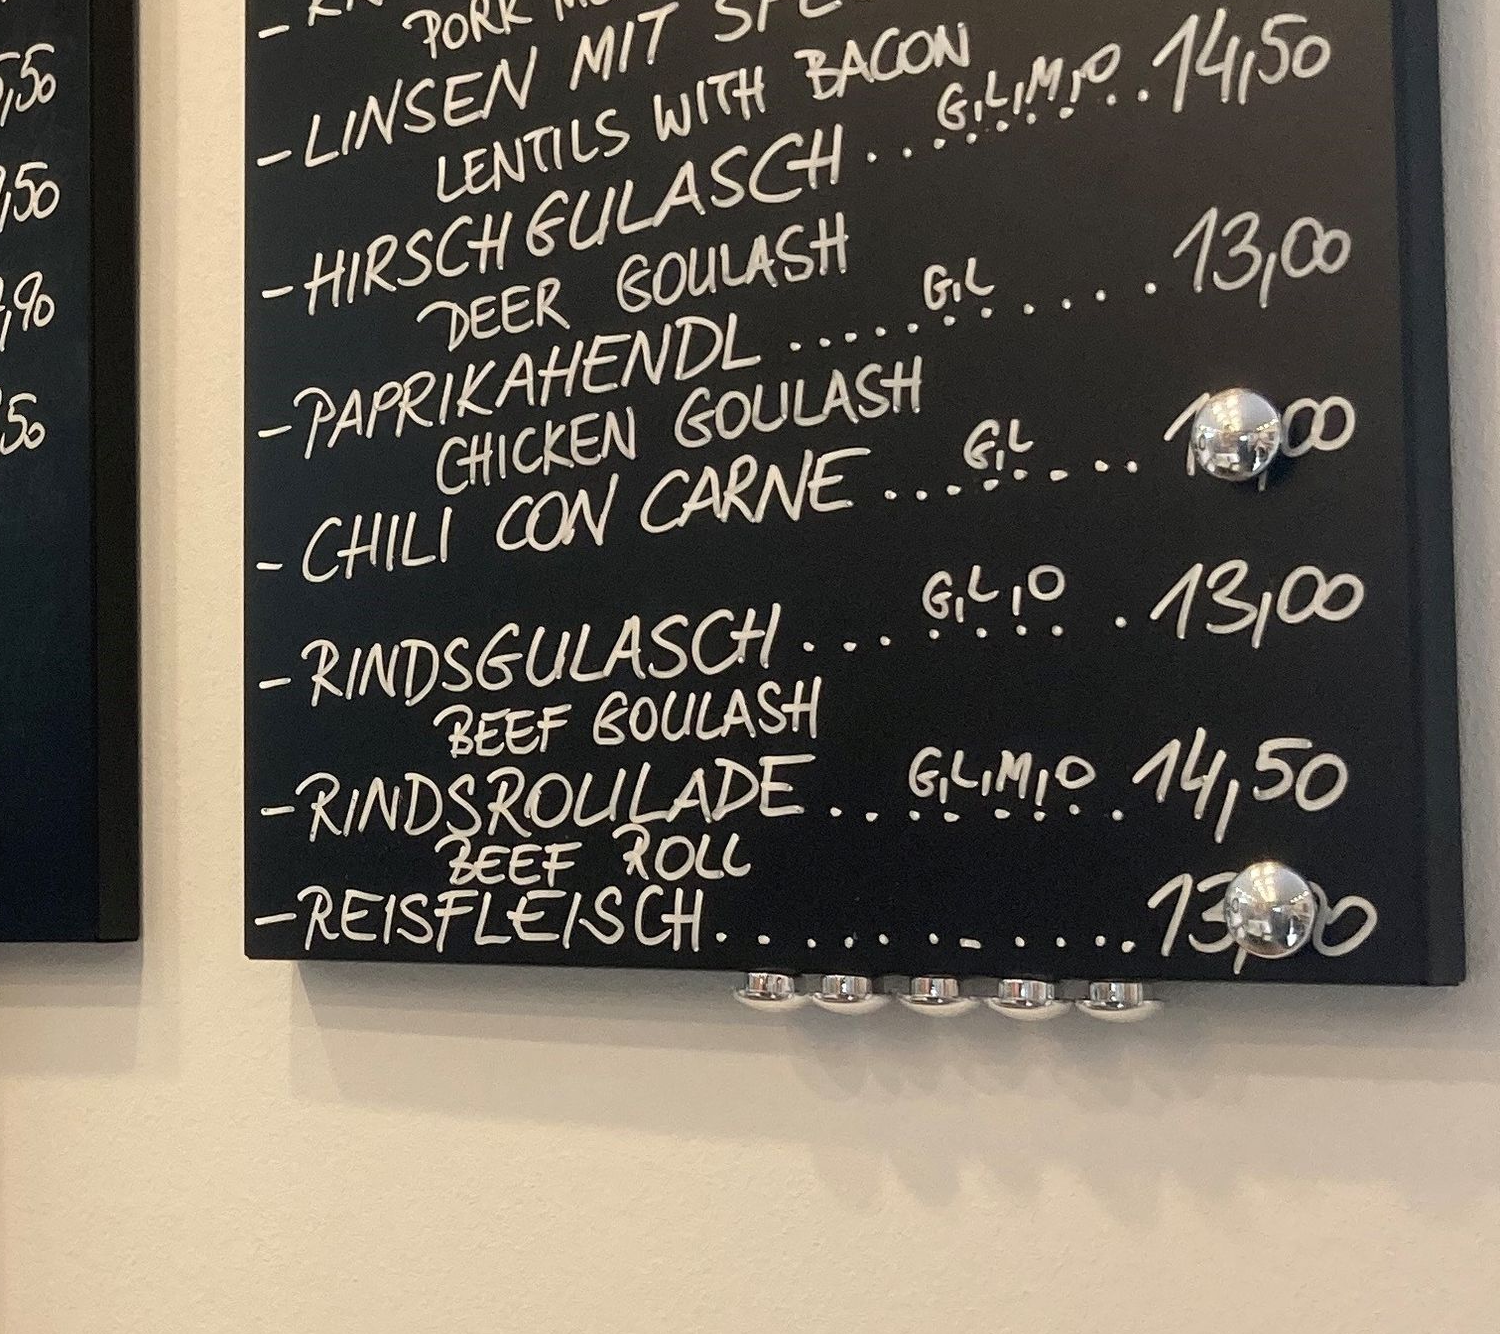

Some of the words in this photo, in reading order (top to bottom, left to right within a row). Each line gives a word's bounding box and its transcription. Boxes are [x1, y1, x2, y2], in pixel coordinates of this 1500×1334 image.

[304, 46, 536, 168] LINSEN
[570, 2, 679, 90] MIT
[436, 110, 631, 203] LENTILS
[654, 67, 765, 142] WITH
[795, 21, 970, 99] BACON
[1153, 8, 1331, 113] 14,50
[294, 313, 760, 459] PAPRIKAHENDL
[1174, 207, 1350, 307] 13,00
[418, 278, 569, 351] DEER
[616, 211, 848, 313] GOULASH
[436, 406, 635, 495] CHICKEN
[674, 356, 921, 449] GOULASH
[301, 506, 451, 582] CHILI
[496, 473, 619, 551] CON
[640, 448, 871, 533] CARNE
[301, 603, 781, 706] RINDSGULASCH
[1151, 558, 1365, 649] 13,00
[296, 753, 815, 841] RINDSROULADE
[1132, 727, 1349, 843] 14,50
[433, 704, 572, 758] BEEF
[594, 677, 822, 746] GOULASH
[297, 884, 703, 952] REISFLEISCH
[435, 835, 582, 886] BEEF
[614, 823, 751, 880] ROLL
